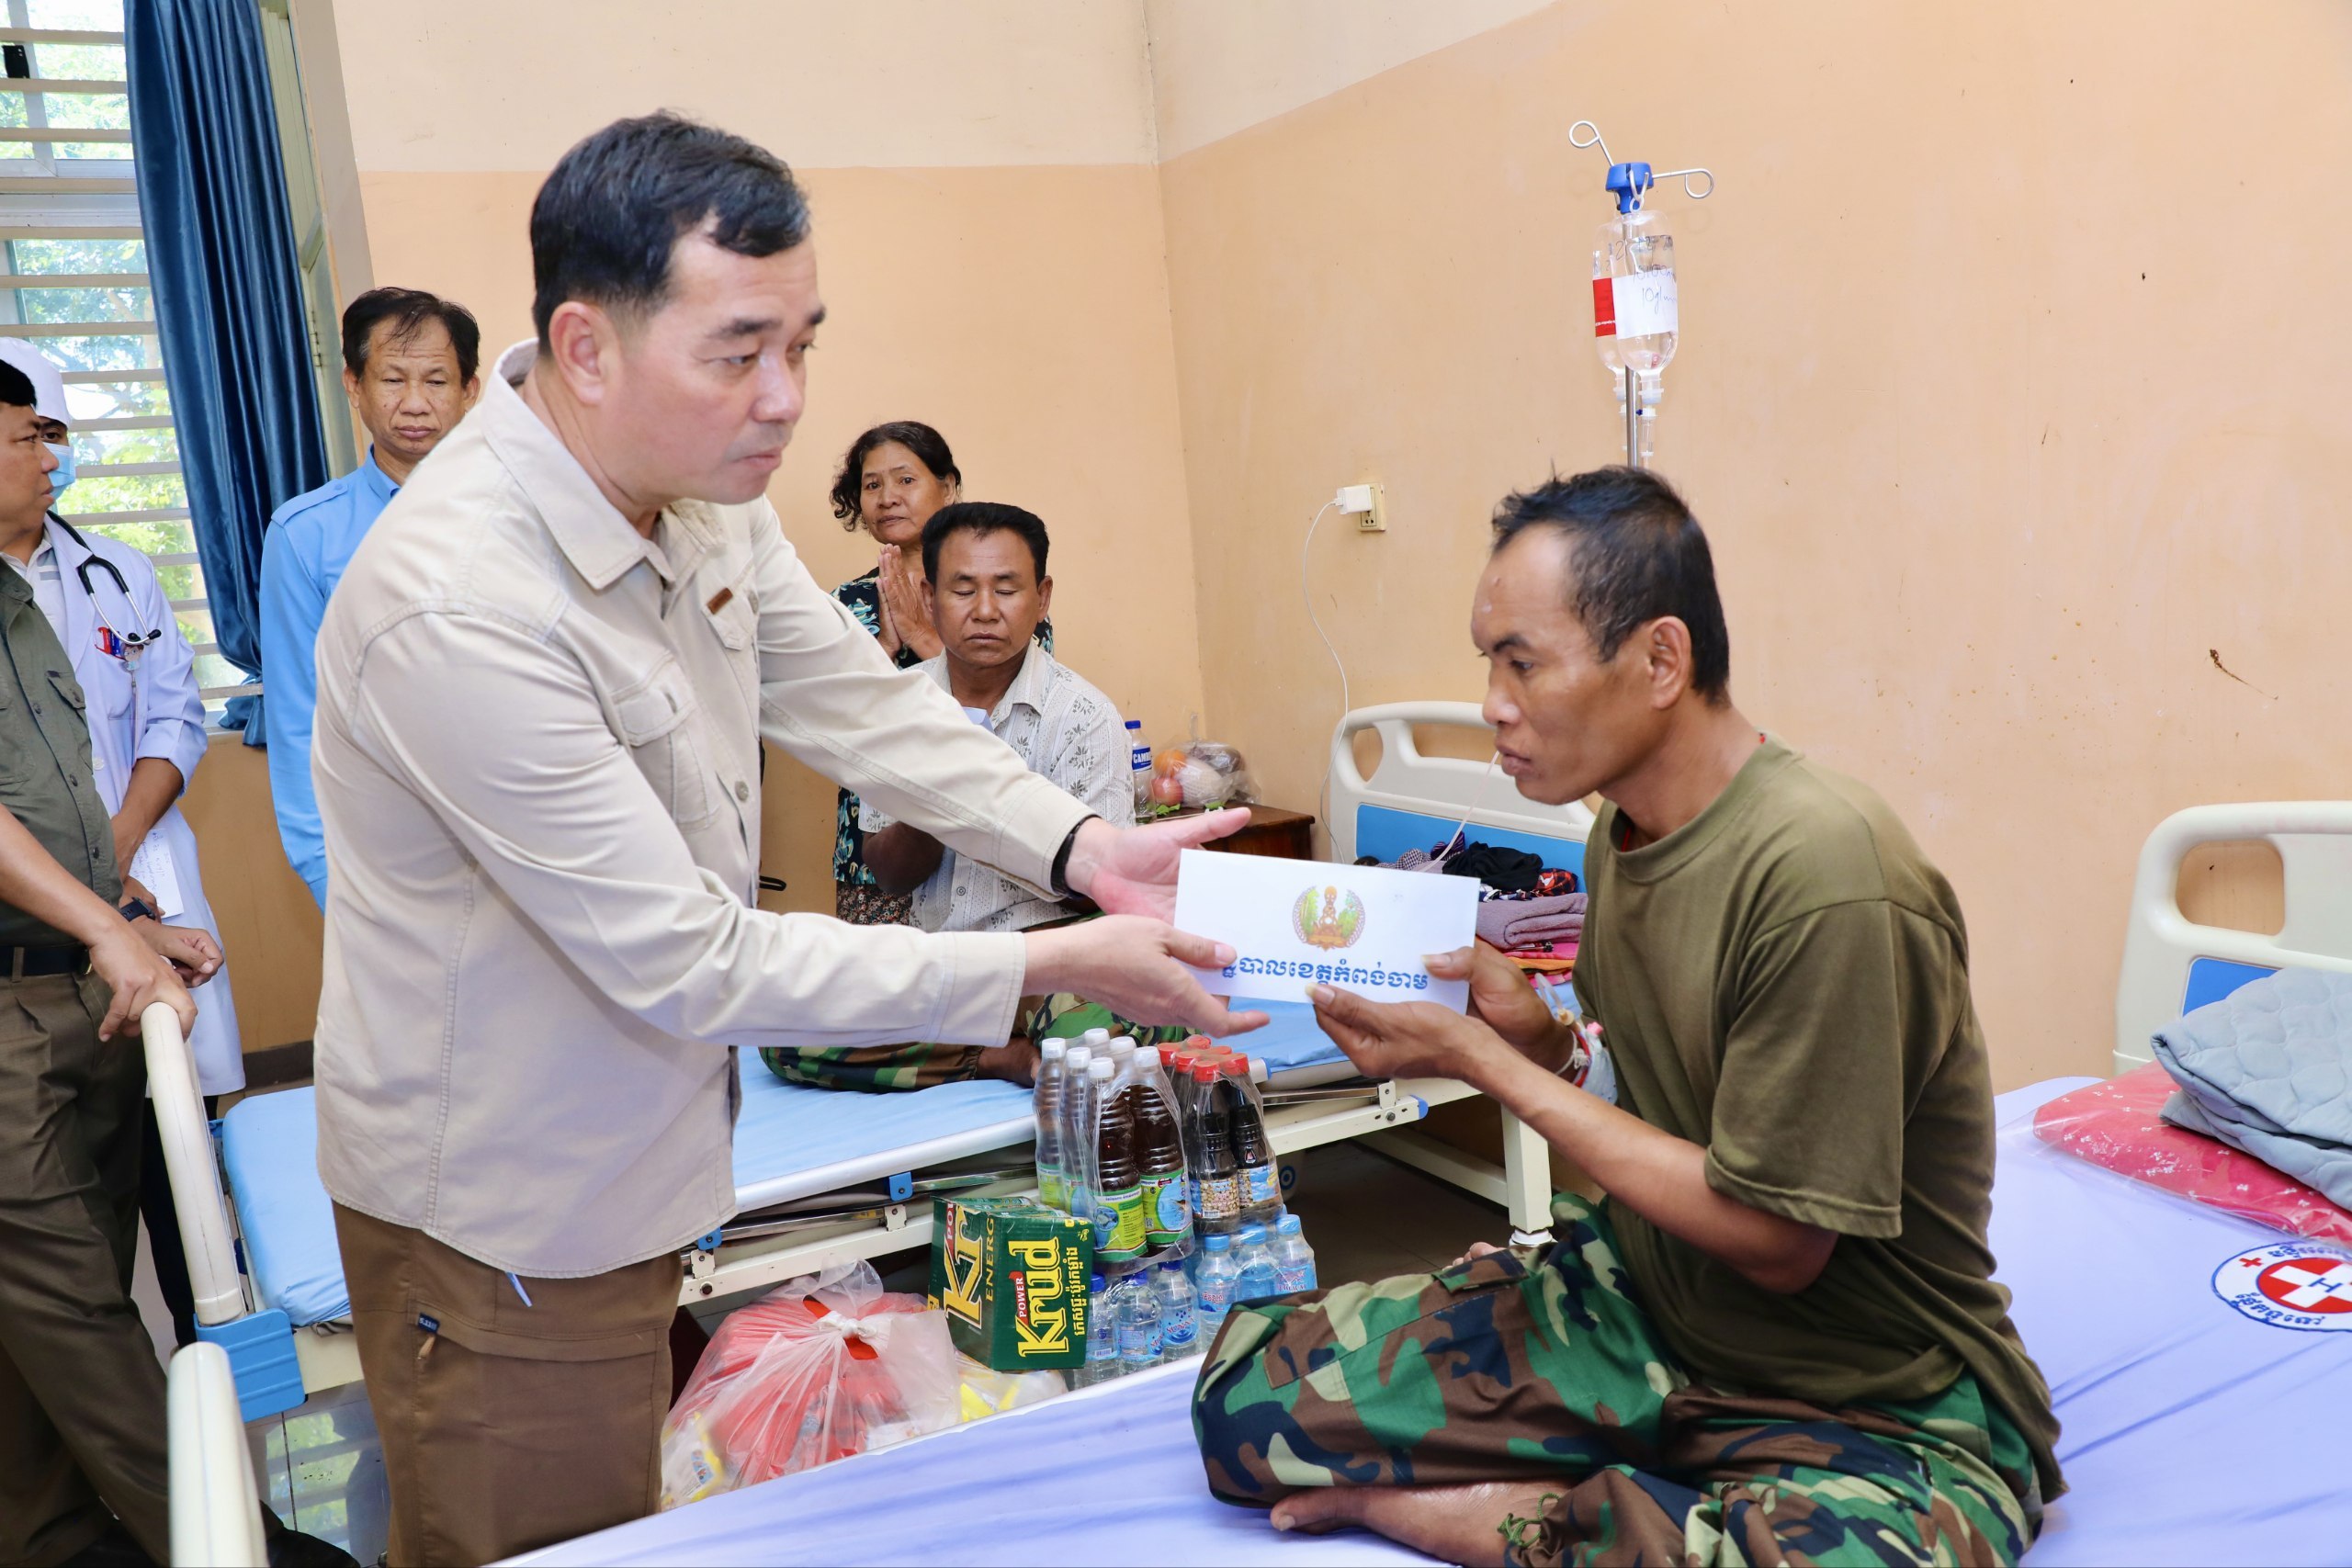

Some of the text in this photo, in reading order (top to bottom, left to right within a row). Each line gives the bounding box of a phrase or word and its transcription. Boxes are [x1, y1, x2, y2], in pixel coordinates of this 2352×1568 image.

[943, 1204, 983, 1329] Kr
[1008, 1236, 1070, 1358] Krud
[1015, 1277, 1028, 1318] POWER
[2307, 1277, 2344, 1292] H
